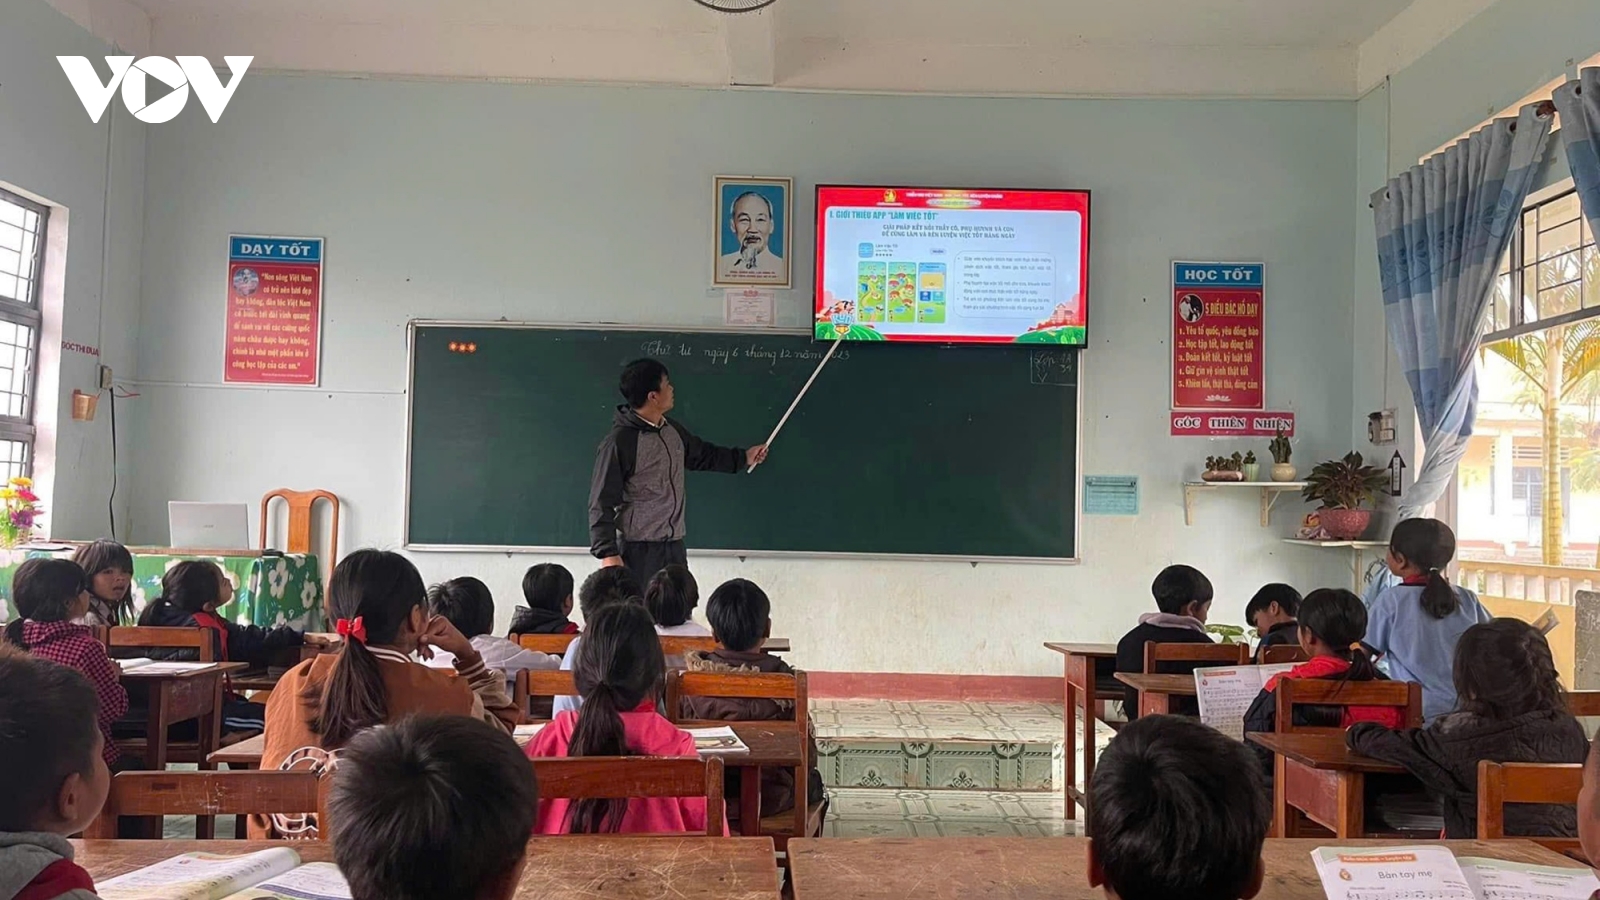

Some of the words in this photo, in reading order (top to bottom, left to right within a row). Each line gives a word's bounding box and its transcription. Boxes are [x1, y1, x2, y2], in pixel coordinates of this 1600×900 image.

[836, 210, 850, 219] GIỚI
[852, 210, 871, 220] THIỆU
[872, 211, 886, 219] APP
[906, 211, 922, 220] VIỆC
[241, 243, 274, 256] DẠY
[279, 242, 311, 256] TỐT
[289, 274, 300, 282] Việt
[301, 274, 312, 282] Nam
[1185, 270, 1218, 282] HỌC
[1222, 267, 1253, 280] TỐT
[287, 298, 298, 308] Việt
[299, 299, 311, 307] Nam
[1205, 302, 1209, 315] 5
[1210, 298, 1224, 315] ĐIỀU
[1225, 300, 1236, 315] BÁC
[1238, 298, 1246, 315] HỒ
[1247, 303, 1258, 318] DẠY
[1186, 326, 1197, 335] Yêu
[1205, 325, 1220, 337] quốc,
[1222, 326, 1232, 337] yêu
[1233, 325, 1247, 338] đồng
[1186, 339, 1197, 350] Học
[1198, 339, 1208, 350] tập
[1220, 340, 1229, 349] lao
[1230, 339, 1244, 350] động
[704, 348, 729, 364] ngày
[732, 347, 739, 357] 6
[745, 344, 776, 366] tháng
[780, 349, 791, 359] 12
[794, 348, 823, 360] năm
[830, 349, 850, 360] 023
[1186, 366, 1196, 375] Giữ
[1214, 366, 1226, 376] sinh
[1174, 415, 1201, 428] GÓC
[1209, 415, 1246, 429] THIÊN
[1378, 871, 1398, 879] Bàn
[1400, 871, 1415, 880] tay
[1418, 871, 1432, 879] mẹ
